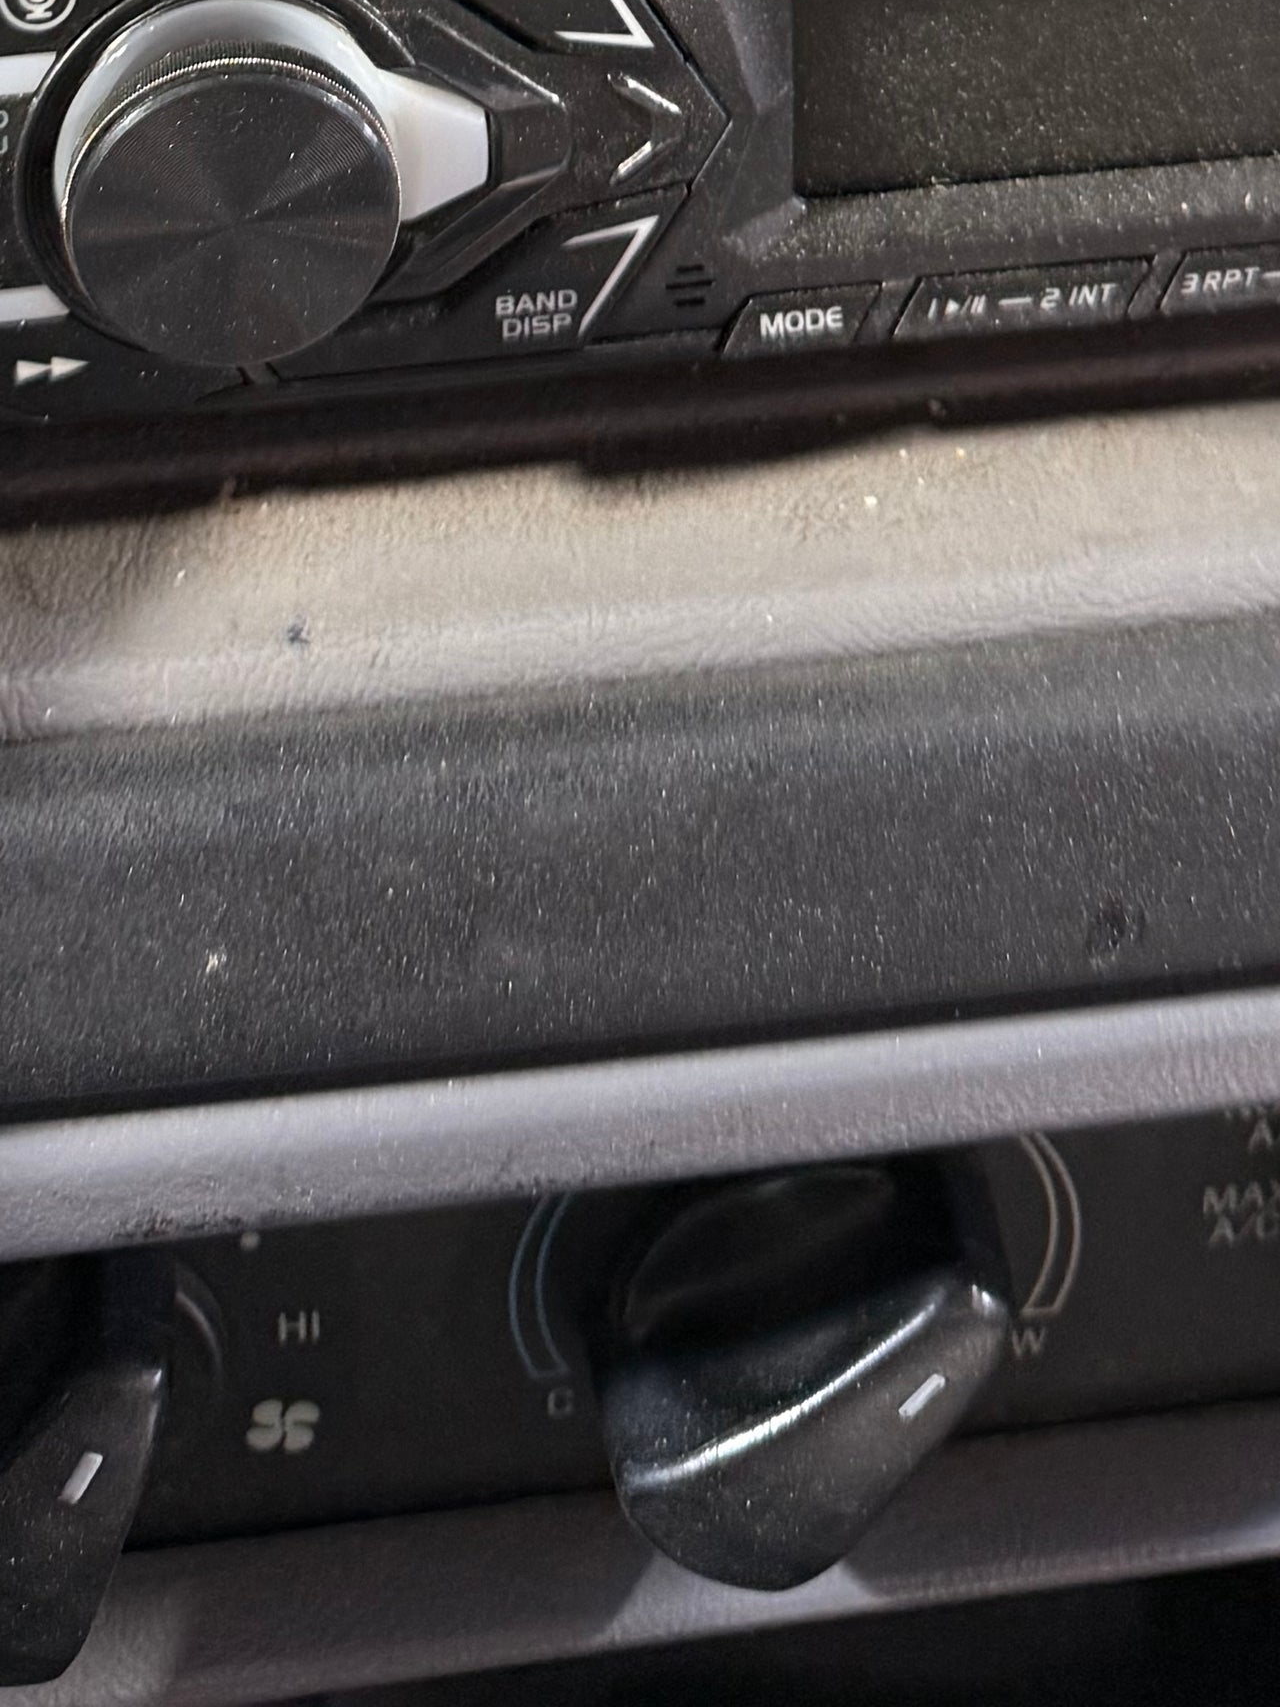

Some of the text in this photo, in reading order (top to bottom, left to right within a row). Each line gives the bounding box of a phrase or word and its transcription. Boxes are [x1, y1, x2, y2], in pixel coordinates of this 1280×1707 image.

[495, 289, 578, 316] BAND
[1068, 283, 1118, 307] INT
[502, 313, 573, 340] DISP
[760, 306, 844, 338] MODE
[1209, 1211, 1280, 1247] A/C
[278, 1311, 320, 1344] HI
[1012, 1327, 1046, 1357] W
